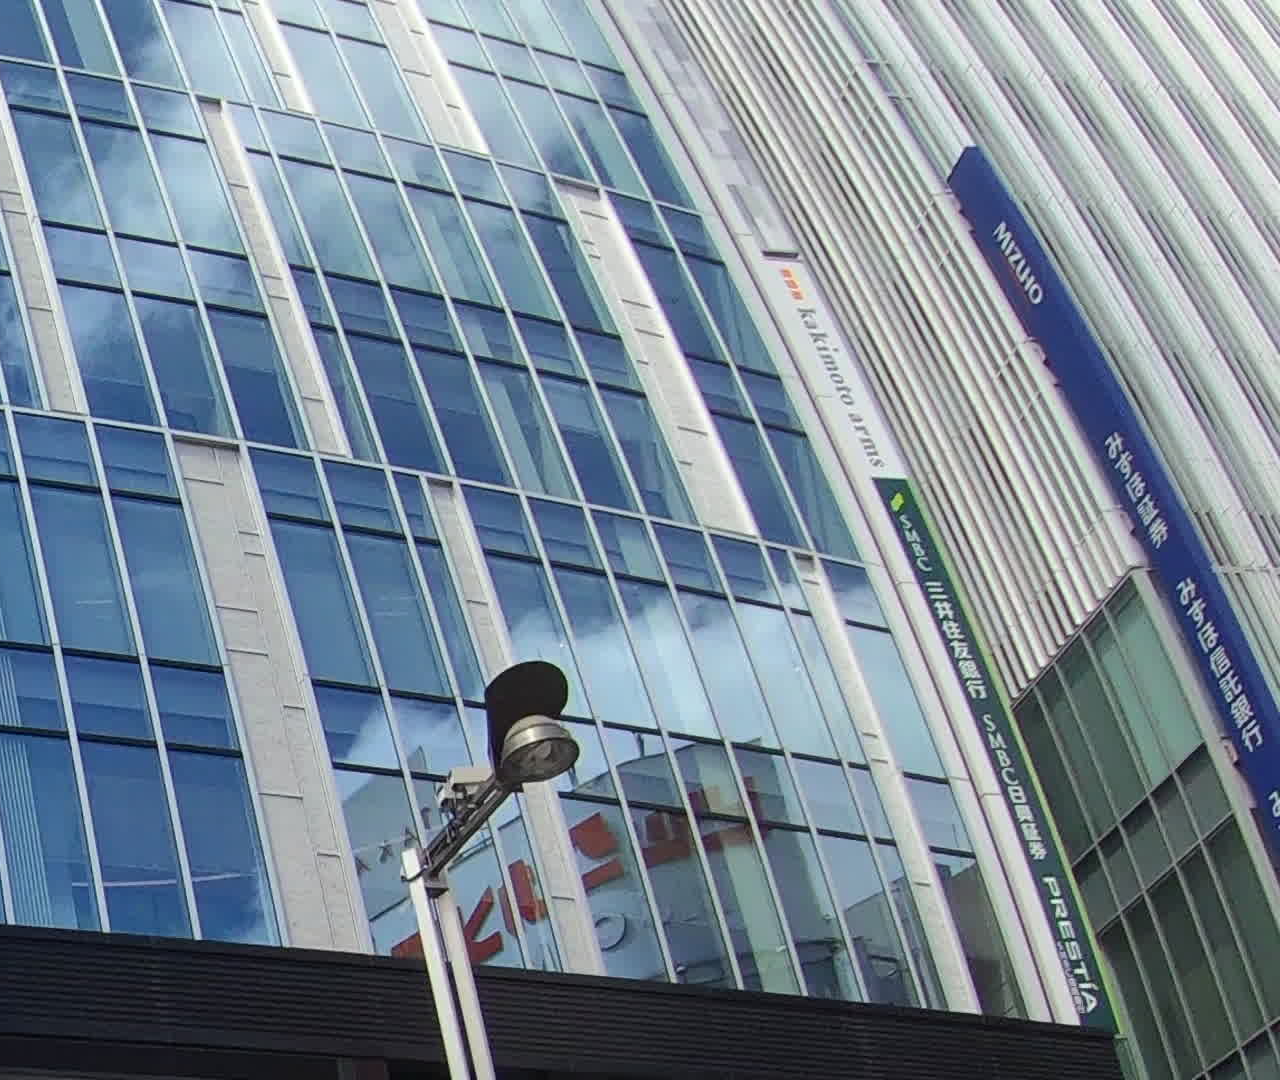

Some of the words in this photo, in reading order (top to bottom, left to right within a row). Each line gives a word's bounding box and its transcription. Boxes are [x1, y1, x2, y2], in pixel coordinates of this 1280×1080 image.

[992, 221, 1043, 305] MIZUHO
[797, 307, 855, 406] kakimoto
[848, 412, 888, 470] arms
[900, 514, 932, 572] SMBC
[925, 581, 988, 699] 三井住友銀行
